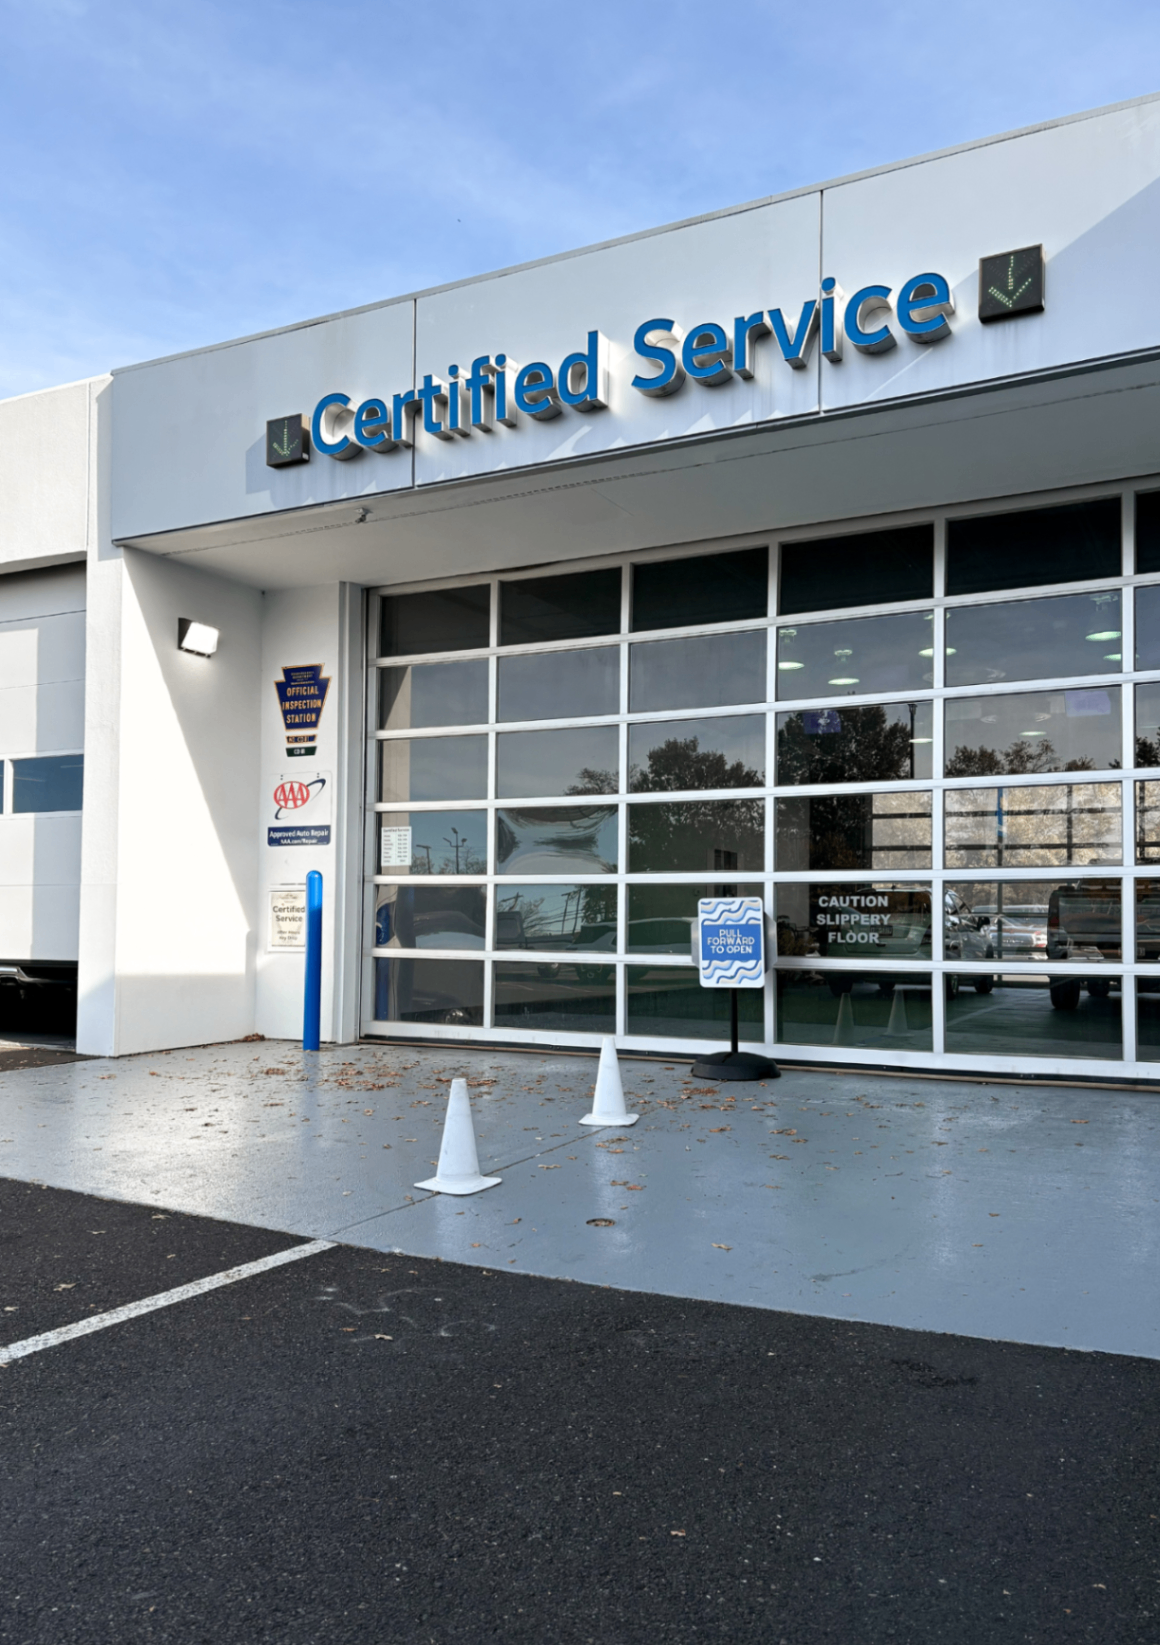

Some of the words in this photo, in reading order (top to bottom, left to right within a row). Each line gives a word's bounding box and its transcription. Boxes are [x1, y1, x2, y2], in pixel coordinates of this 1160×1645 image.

[309, 329, 600, 456] Certified
[630, 271, 953, 392] Service
[286, 686, 319, 697] OFFICIAL
[282, 699, 322, 711] INSPECTION
[286, 713, 317, 724] STATION
[275, 781, 310, 809] AAA
[269, 830, 296, 839] Approved
[311, 828, 329, 837] Repair
[818, 895, 889, 907] CAUTION
[272, 905, 306, 914] Certified
[275, 914, 304, 923] Service
[816, 914, 891, 925] SLIPPERY
[719, 929, 742, 938] PULL
[828, 932, 879, 943] FLOOR
[707, 937, 755, 946] FORWARD
[710, 945, 725, 954] TO
[726, 945, 753, 954] OPEN
